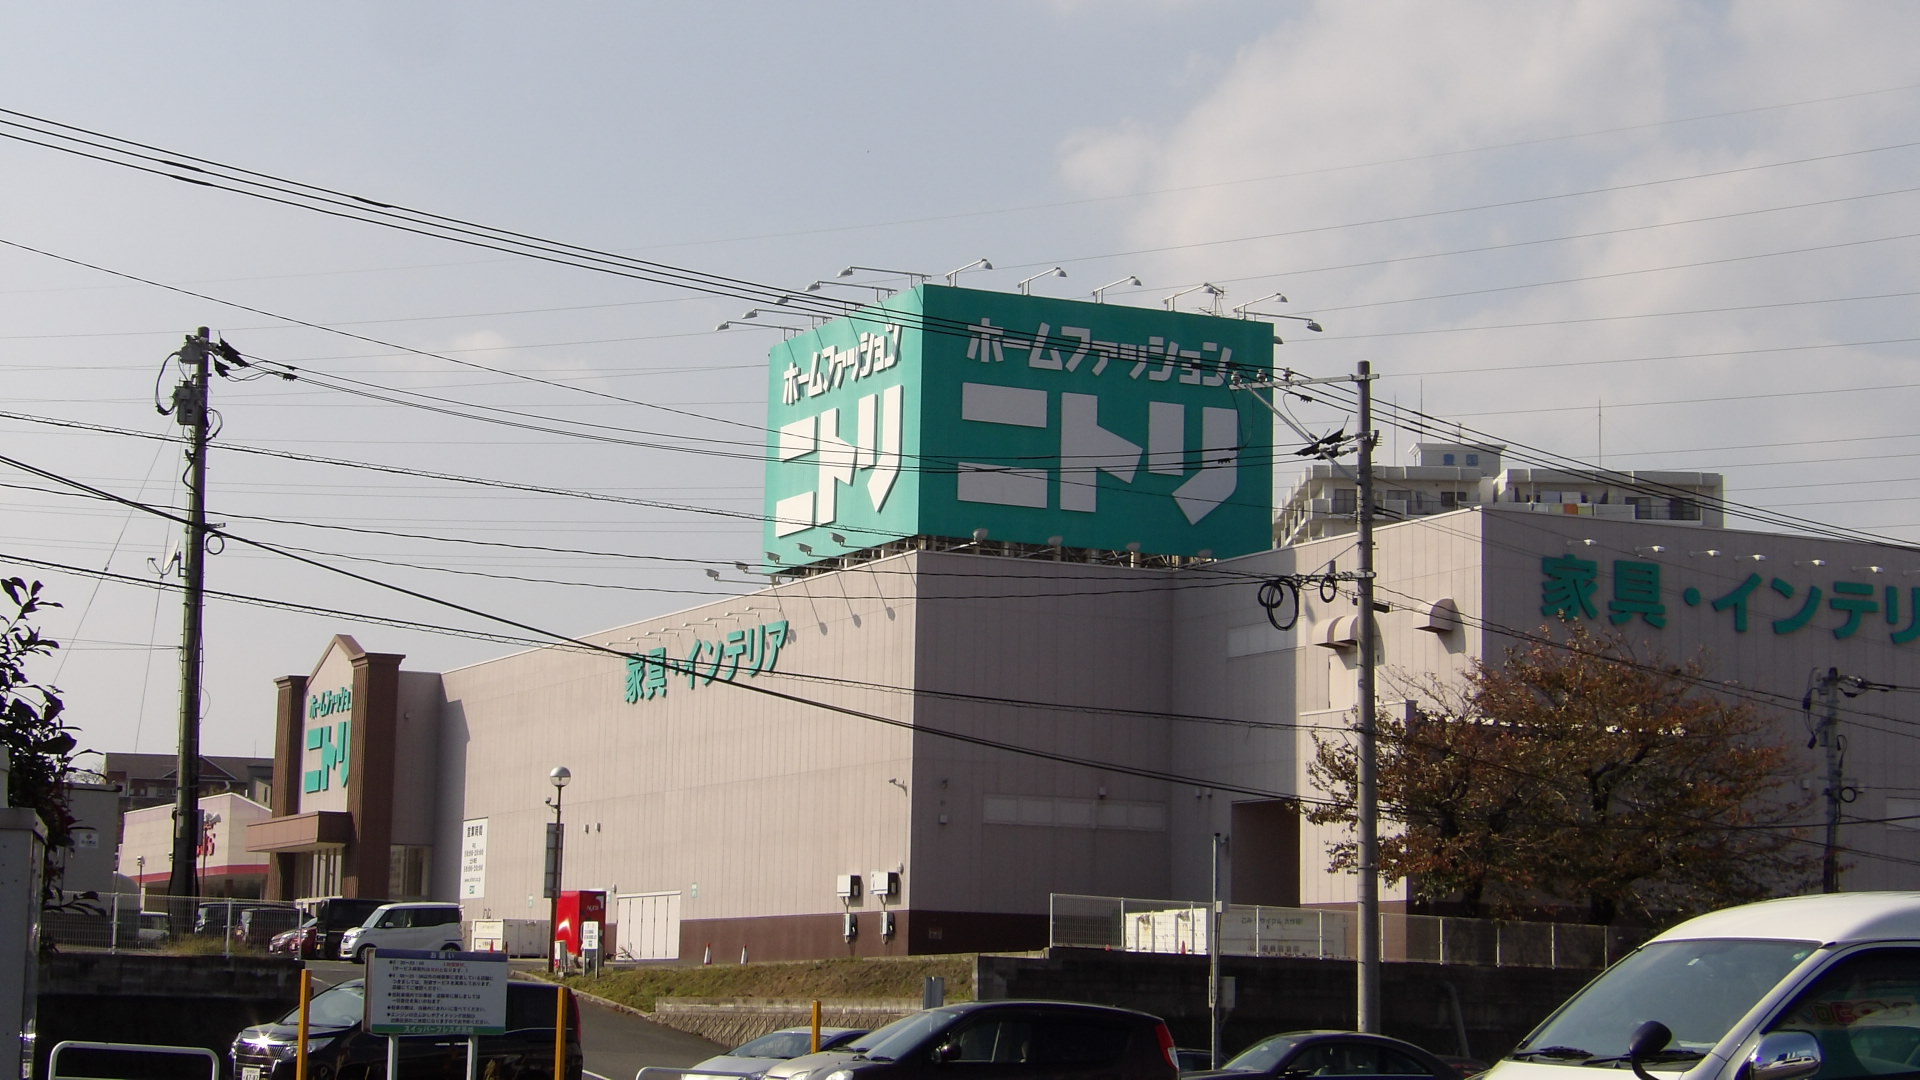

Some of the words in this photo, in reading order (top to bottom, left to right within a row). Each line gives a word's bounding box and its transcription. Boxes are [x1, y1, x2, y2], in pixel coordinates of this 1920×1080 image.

[783, 322, 903, 405] ホームファッション
[966, 317, 1233, 384] ホームファッション
[774, 384, 904, 538] ニトリ
[956, 381, 1239, 526] ニトリ
[624, 620, 790, 704] 家具・インテリア
